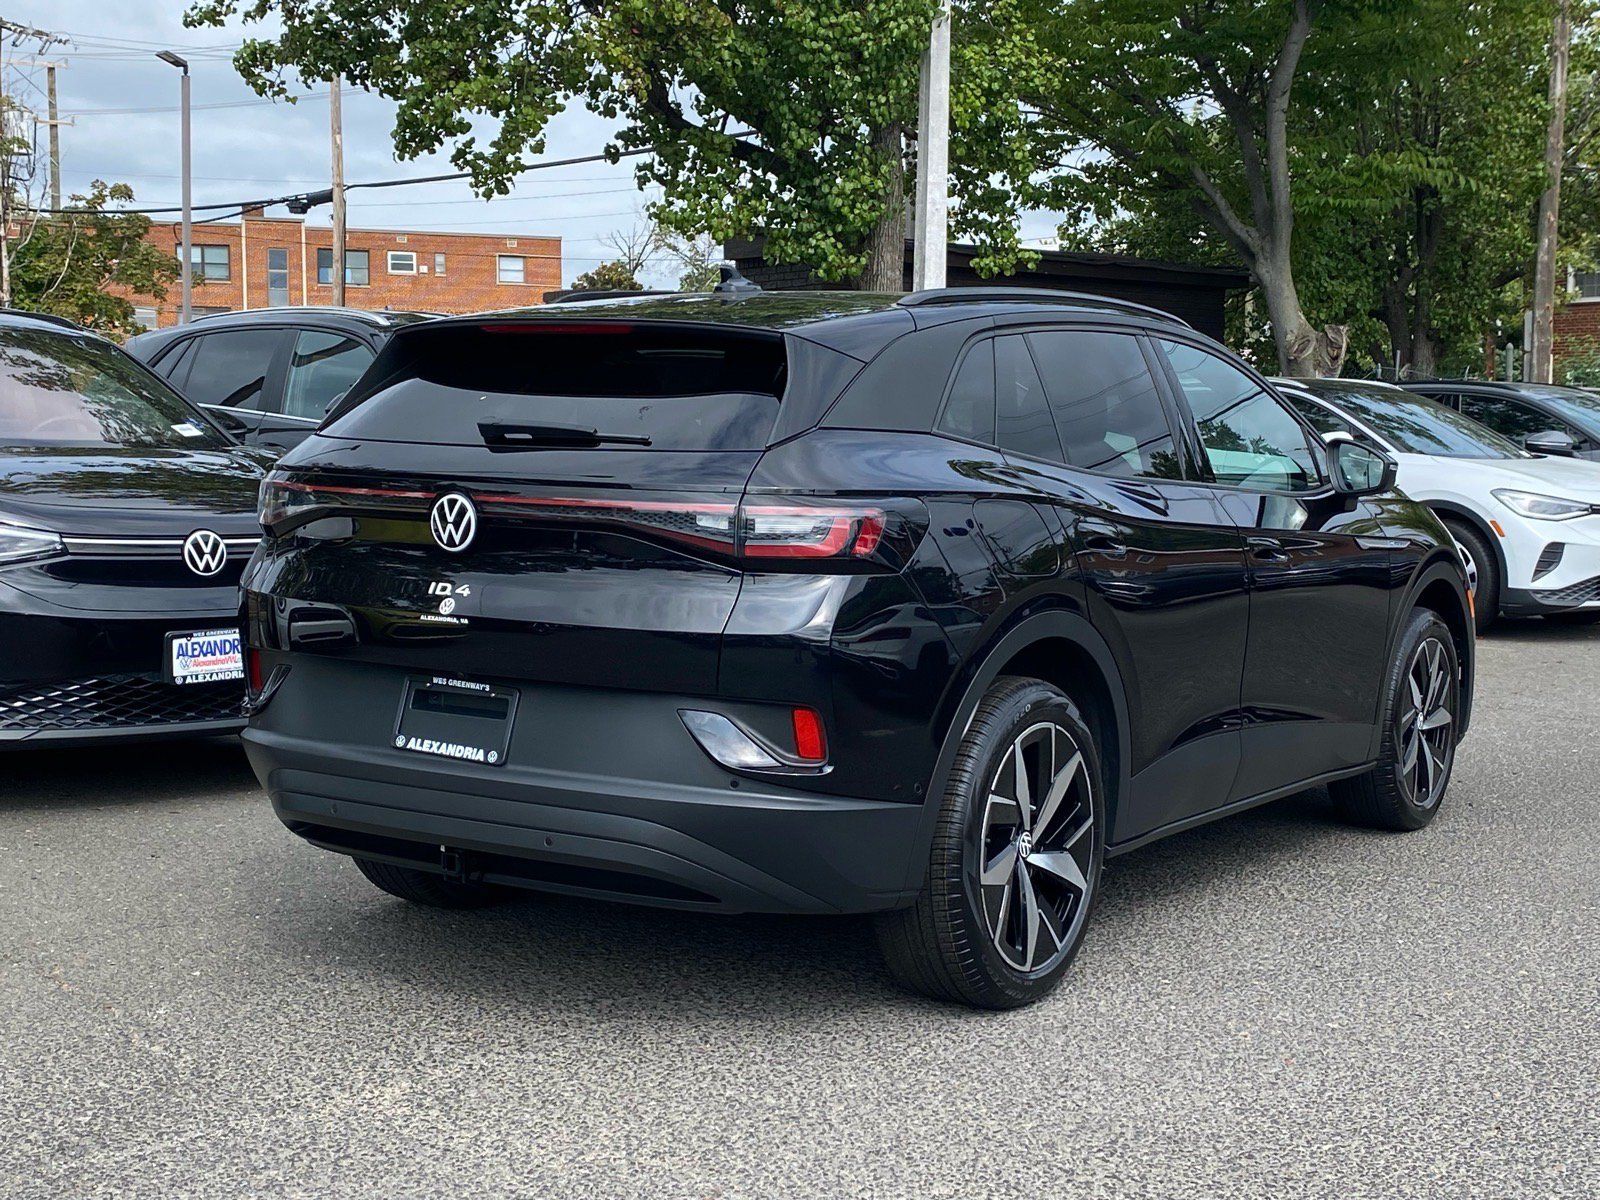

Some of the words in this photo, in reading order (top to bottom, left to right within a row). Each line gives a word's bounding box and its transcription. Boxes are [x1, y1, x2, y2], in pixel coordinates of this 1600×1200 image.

[176, 639, 241, 659] ALEXANDR
[433, 677, 447, 685] WES
[448, 679, 490, 692] GREENWAY'S
[407, 737, 484, 761] ALEXANDRIA
